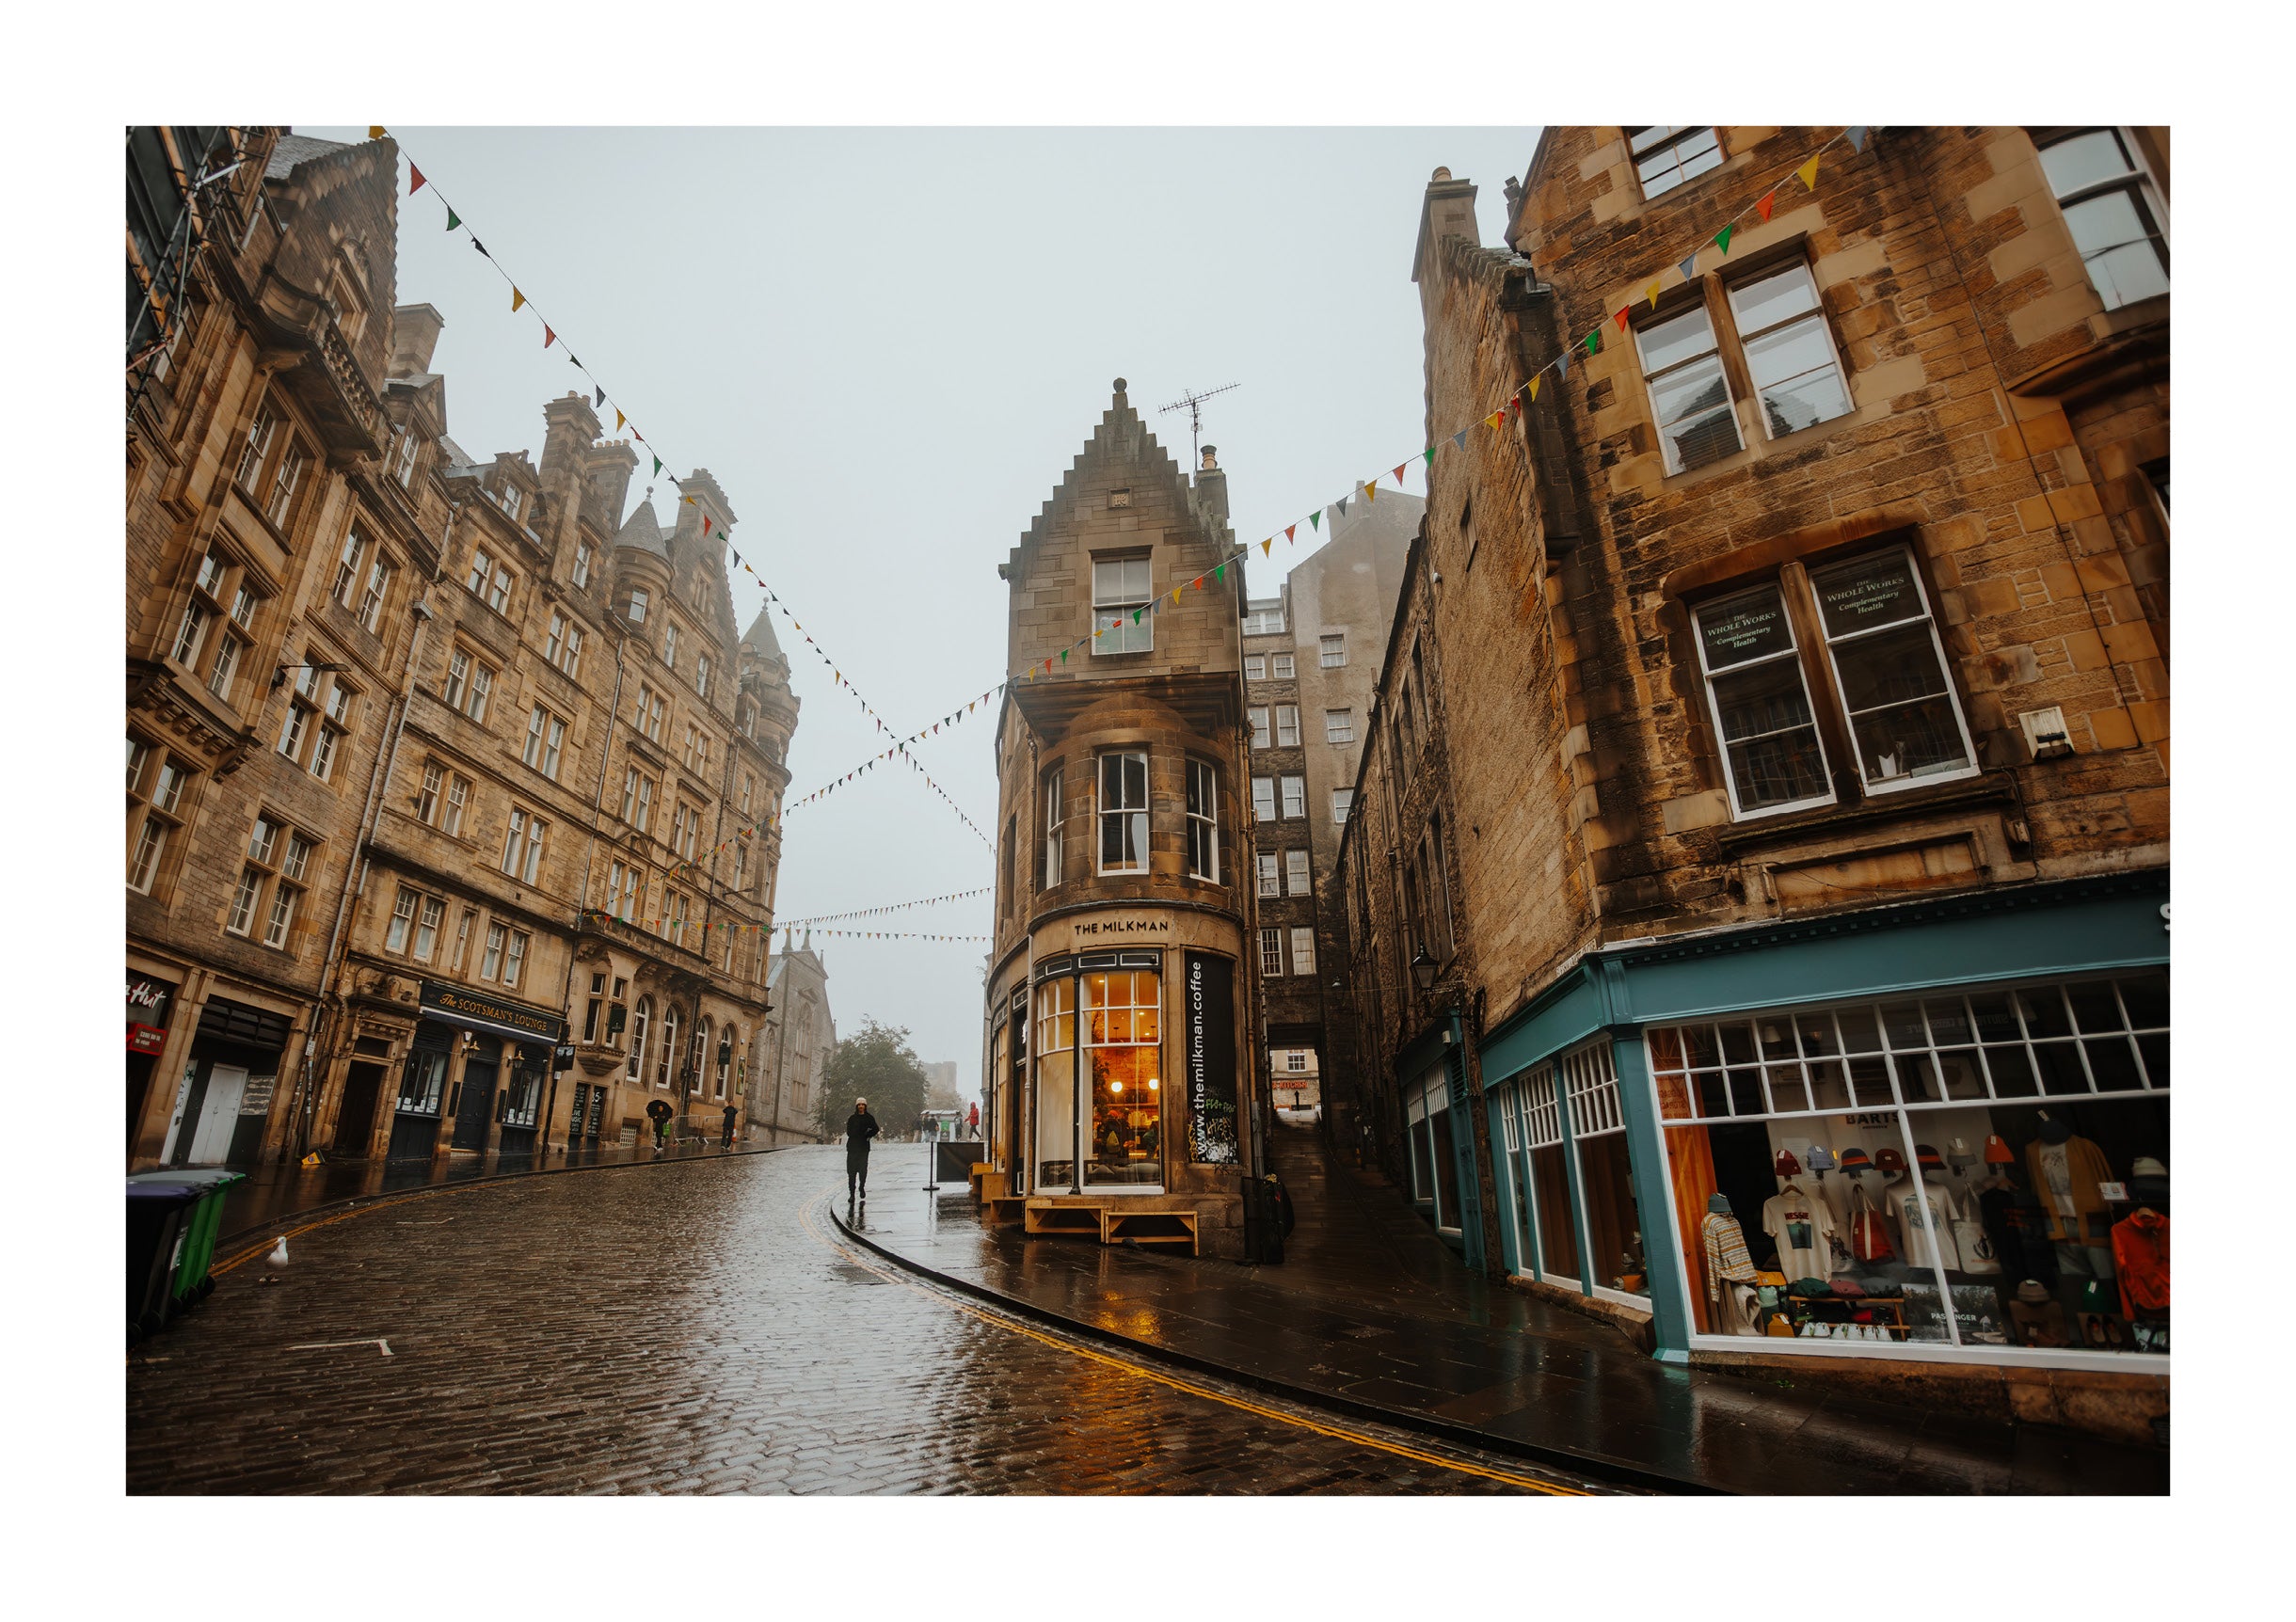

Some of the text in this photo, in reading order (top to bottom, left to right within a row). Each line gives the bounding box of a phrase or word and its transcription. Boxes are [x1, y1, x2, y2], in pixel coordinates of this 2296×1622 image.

[1826, 577, 1905, 602] WHOLE WORKS
[1839, 591, 1899, 612] Complementary
[1858, 602, 1884, 614] Health
[1707, 612, 1777, 637] WHOLE WORKS
[1733, 613, 1746, 622] THE
[1716, 626, 1771, 645] Complementary
[1733, 637, 1757, 648] Health
[1075, 921, 1168, 935] THE MILKMAN
[130, 981, 167, 1009] Hut
[439, 994, 548, 1031] The SCOTSMAN'S LOUNGE
[1845, 1112, 1899, 1124] BARTS
[1931, 1312, 1977, 1321] PASNGER
